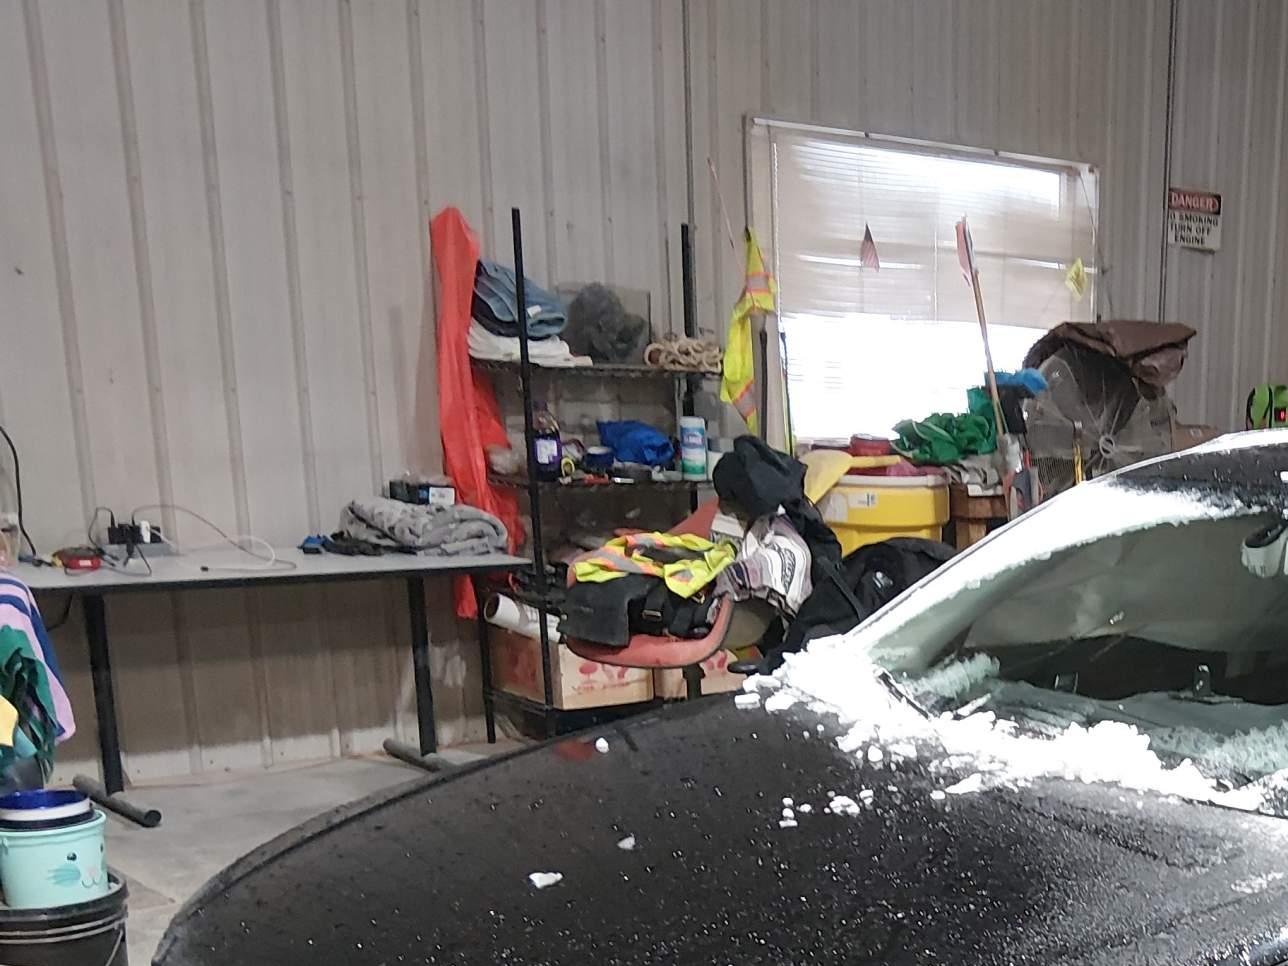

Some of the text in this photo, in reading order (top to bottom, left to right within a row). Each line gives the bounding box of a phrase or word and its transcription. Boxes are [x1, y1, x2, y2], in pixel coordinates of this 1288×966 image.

[1170, 191, 1214, 212] DANGER
[1179, 213, 1219, 227] SMOKING
[1174, 234, 1206, 245] ENGINE
